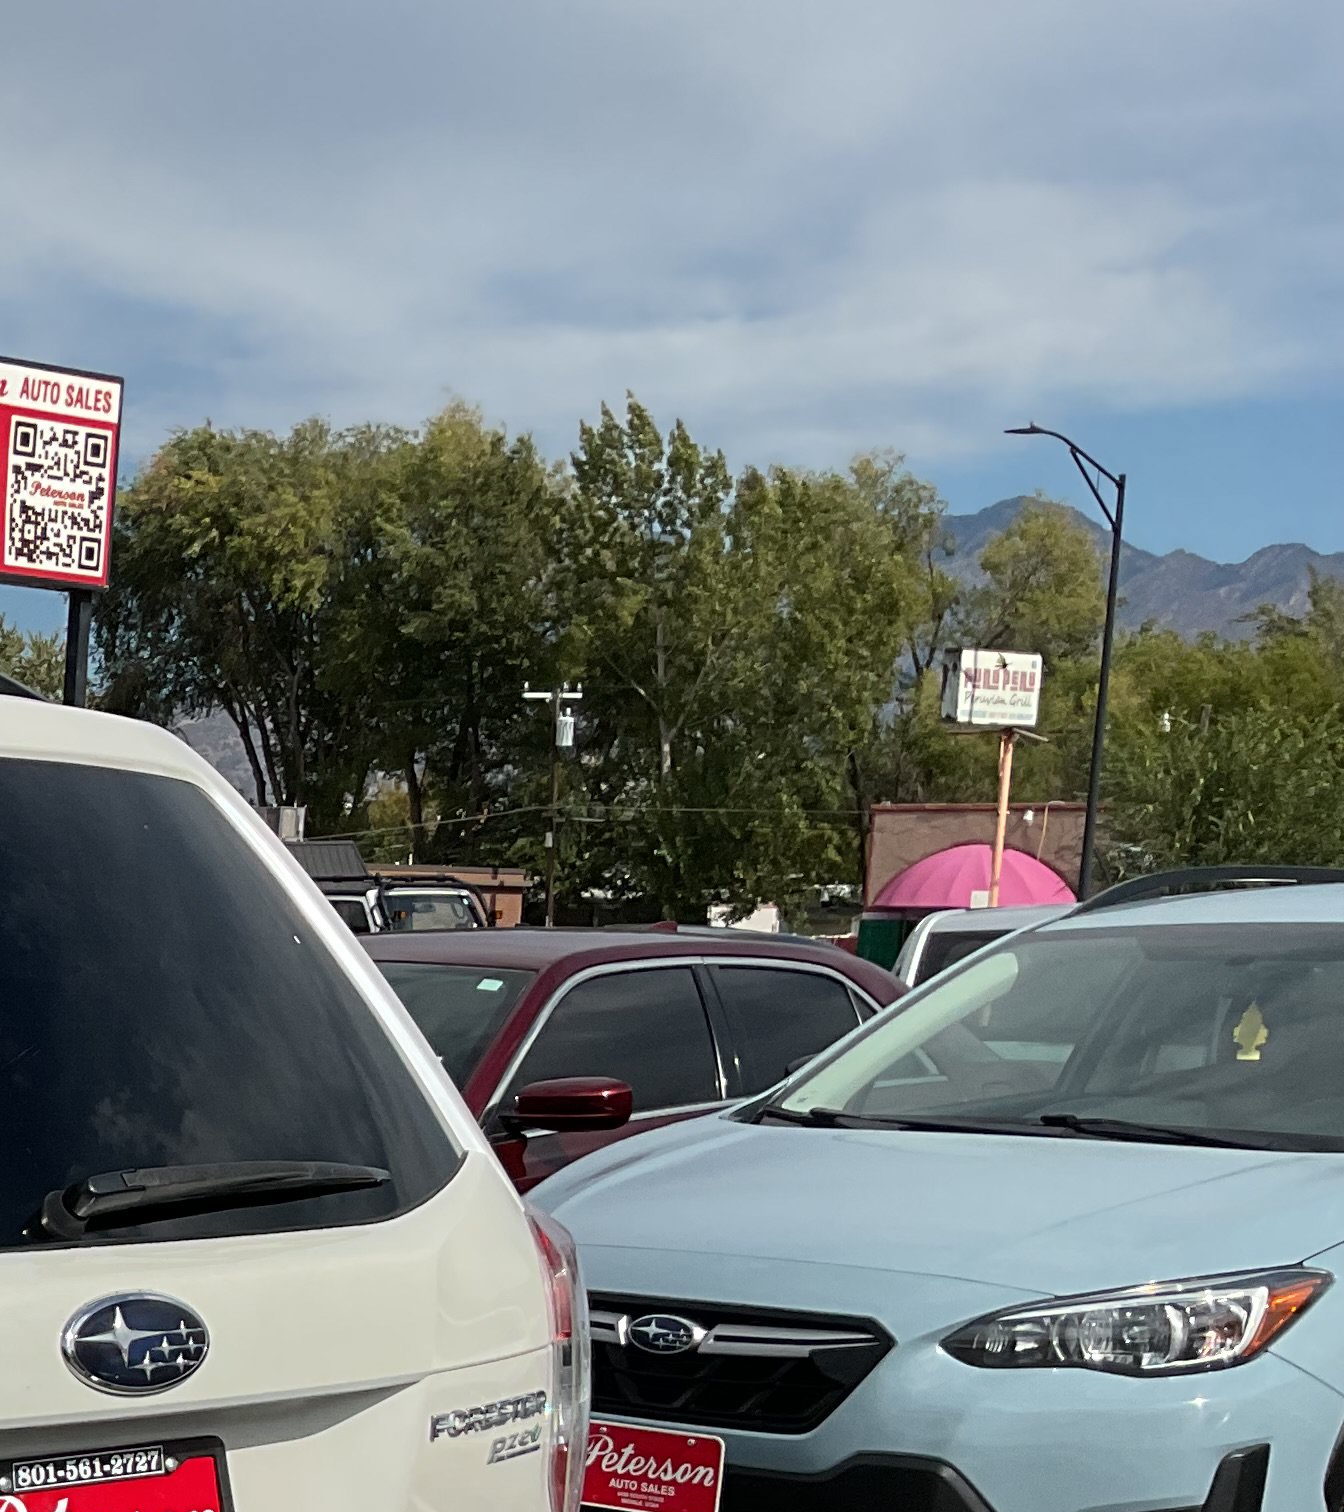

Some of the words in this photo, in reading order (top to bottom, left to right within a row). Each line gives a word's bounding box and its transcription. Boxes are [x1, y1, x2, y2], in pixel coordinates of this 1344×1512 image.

[19, 377, 60, 405] AUTO
[65, 384, 112, 414] SALES
[29, 481, 85, 502] Peterson
[964, 691, 1007, 706] Pruvian
[17, 1450, 160, 1487] 801-561-2727
[585, 1434, 714, 1487] Peterson
[608, 1477, 638, 1491] AUTO
[640, 1482, 676, 1497] SALES
